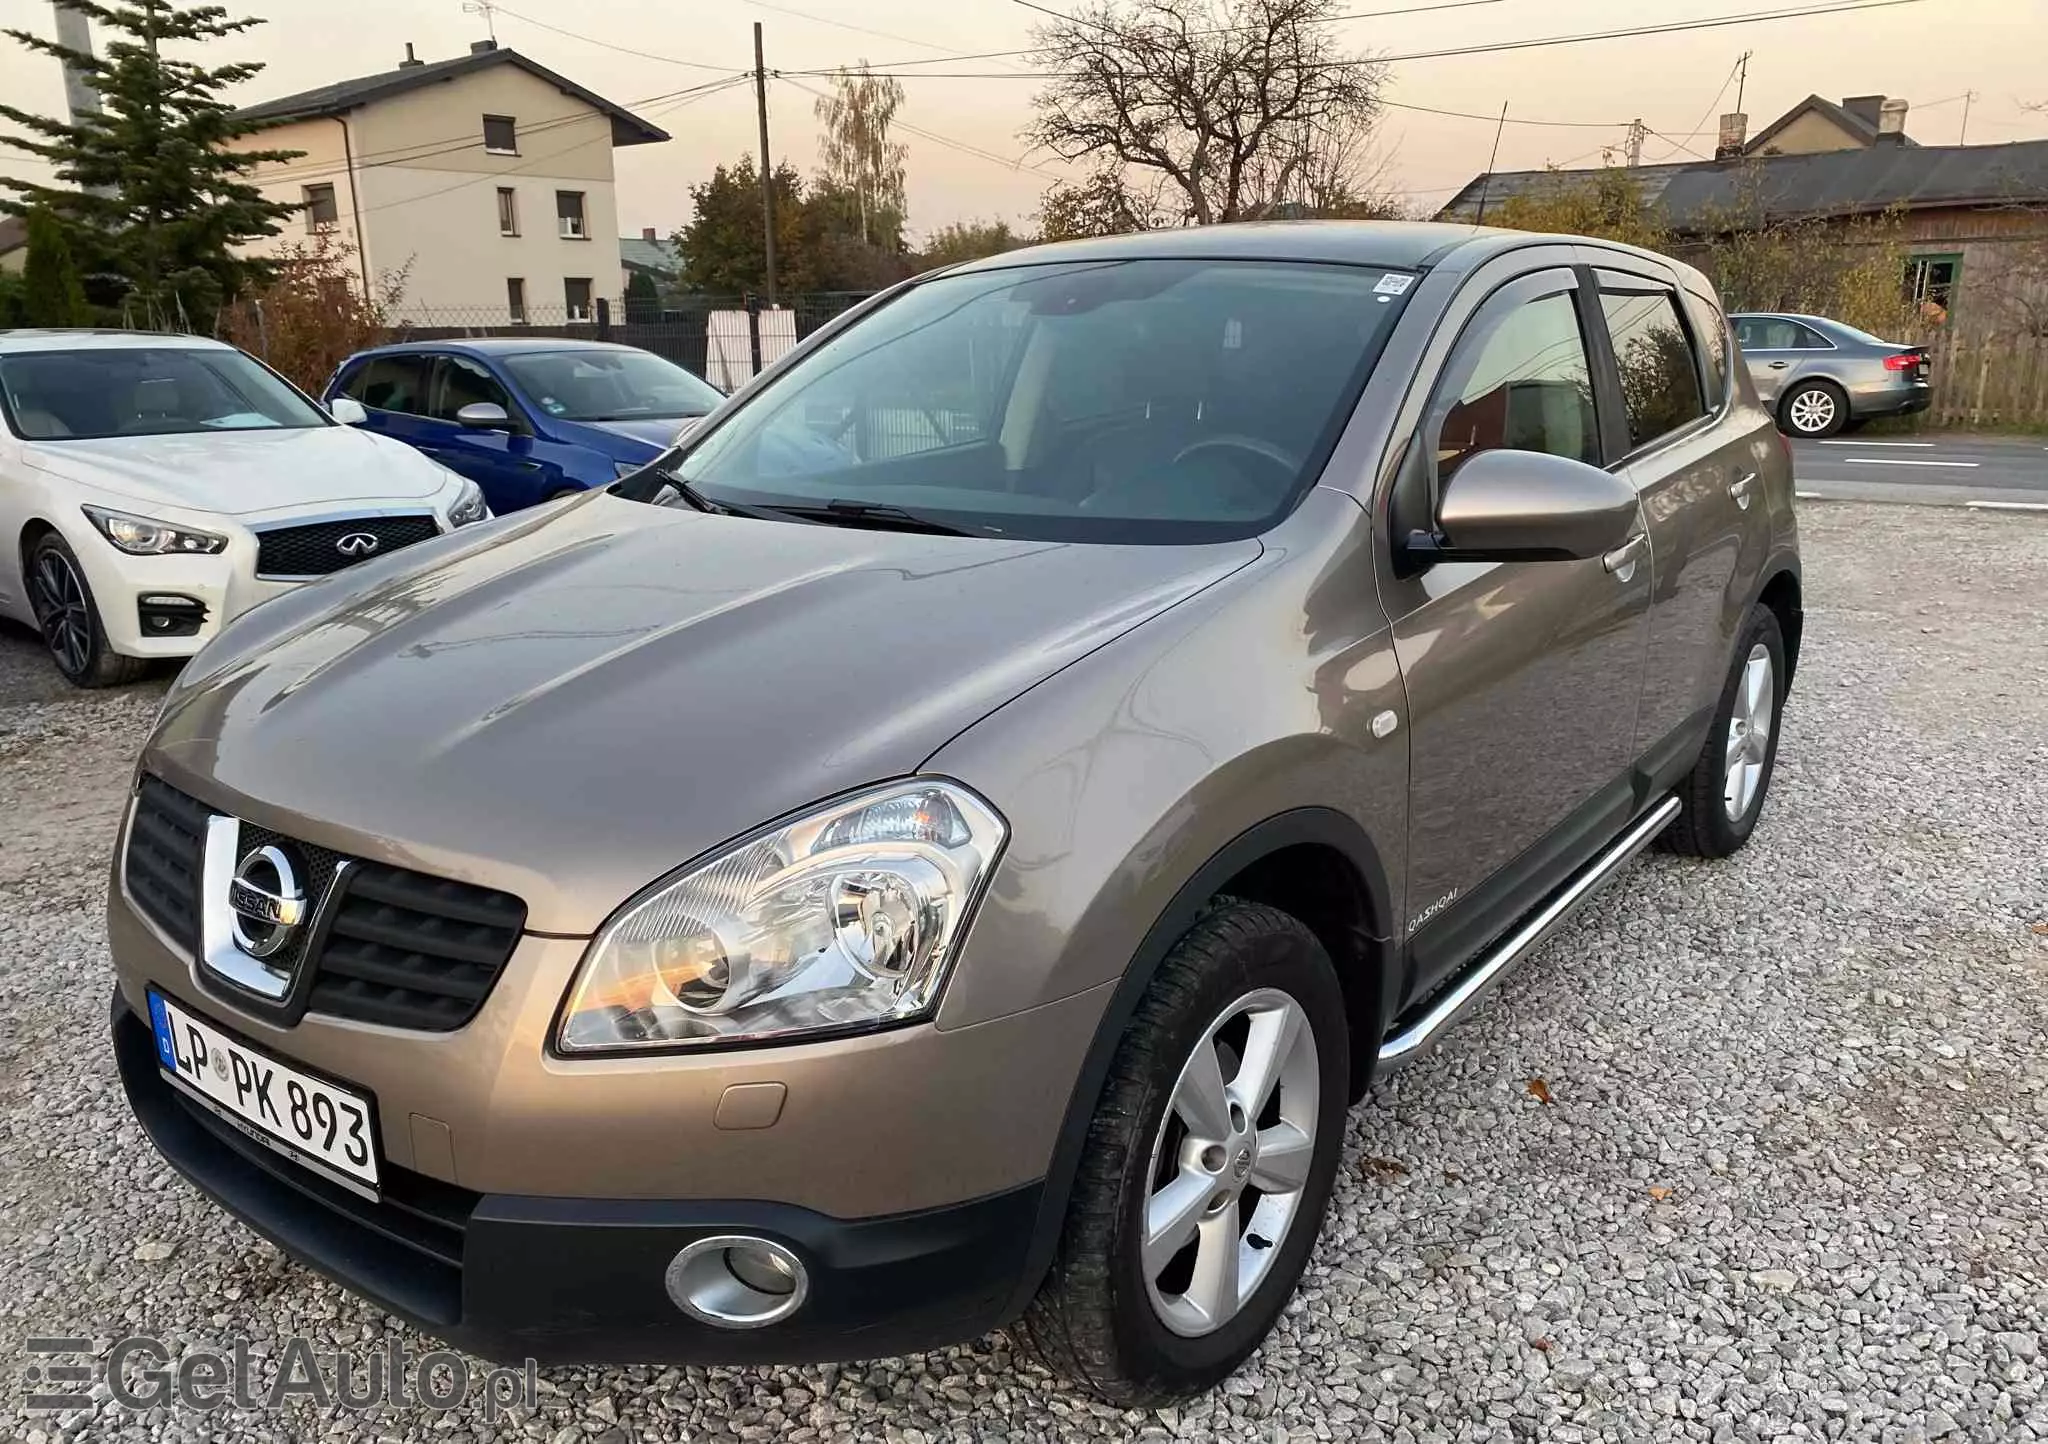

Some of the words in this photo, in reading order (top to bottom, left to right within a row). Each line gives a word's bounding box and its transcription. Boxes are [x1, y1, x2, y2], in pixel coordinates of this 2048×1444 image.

[1408, 887, 1458, 932] QASHQAI
[168, 1012, 208, 1080] LP
[228, 1048, 282, 1128] PK
[287, 1079, 368, 1167] 893
